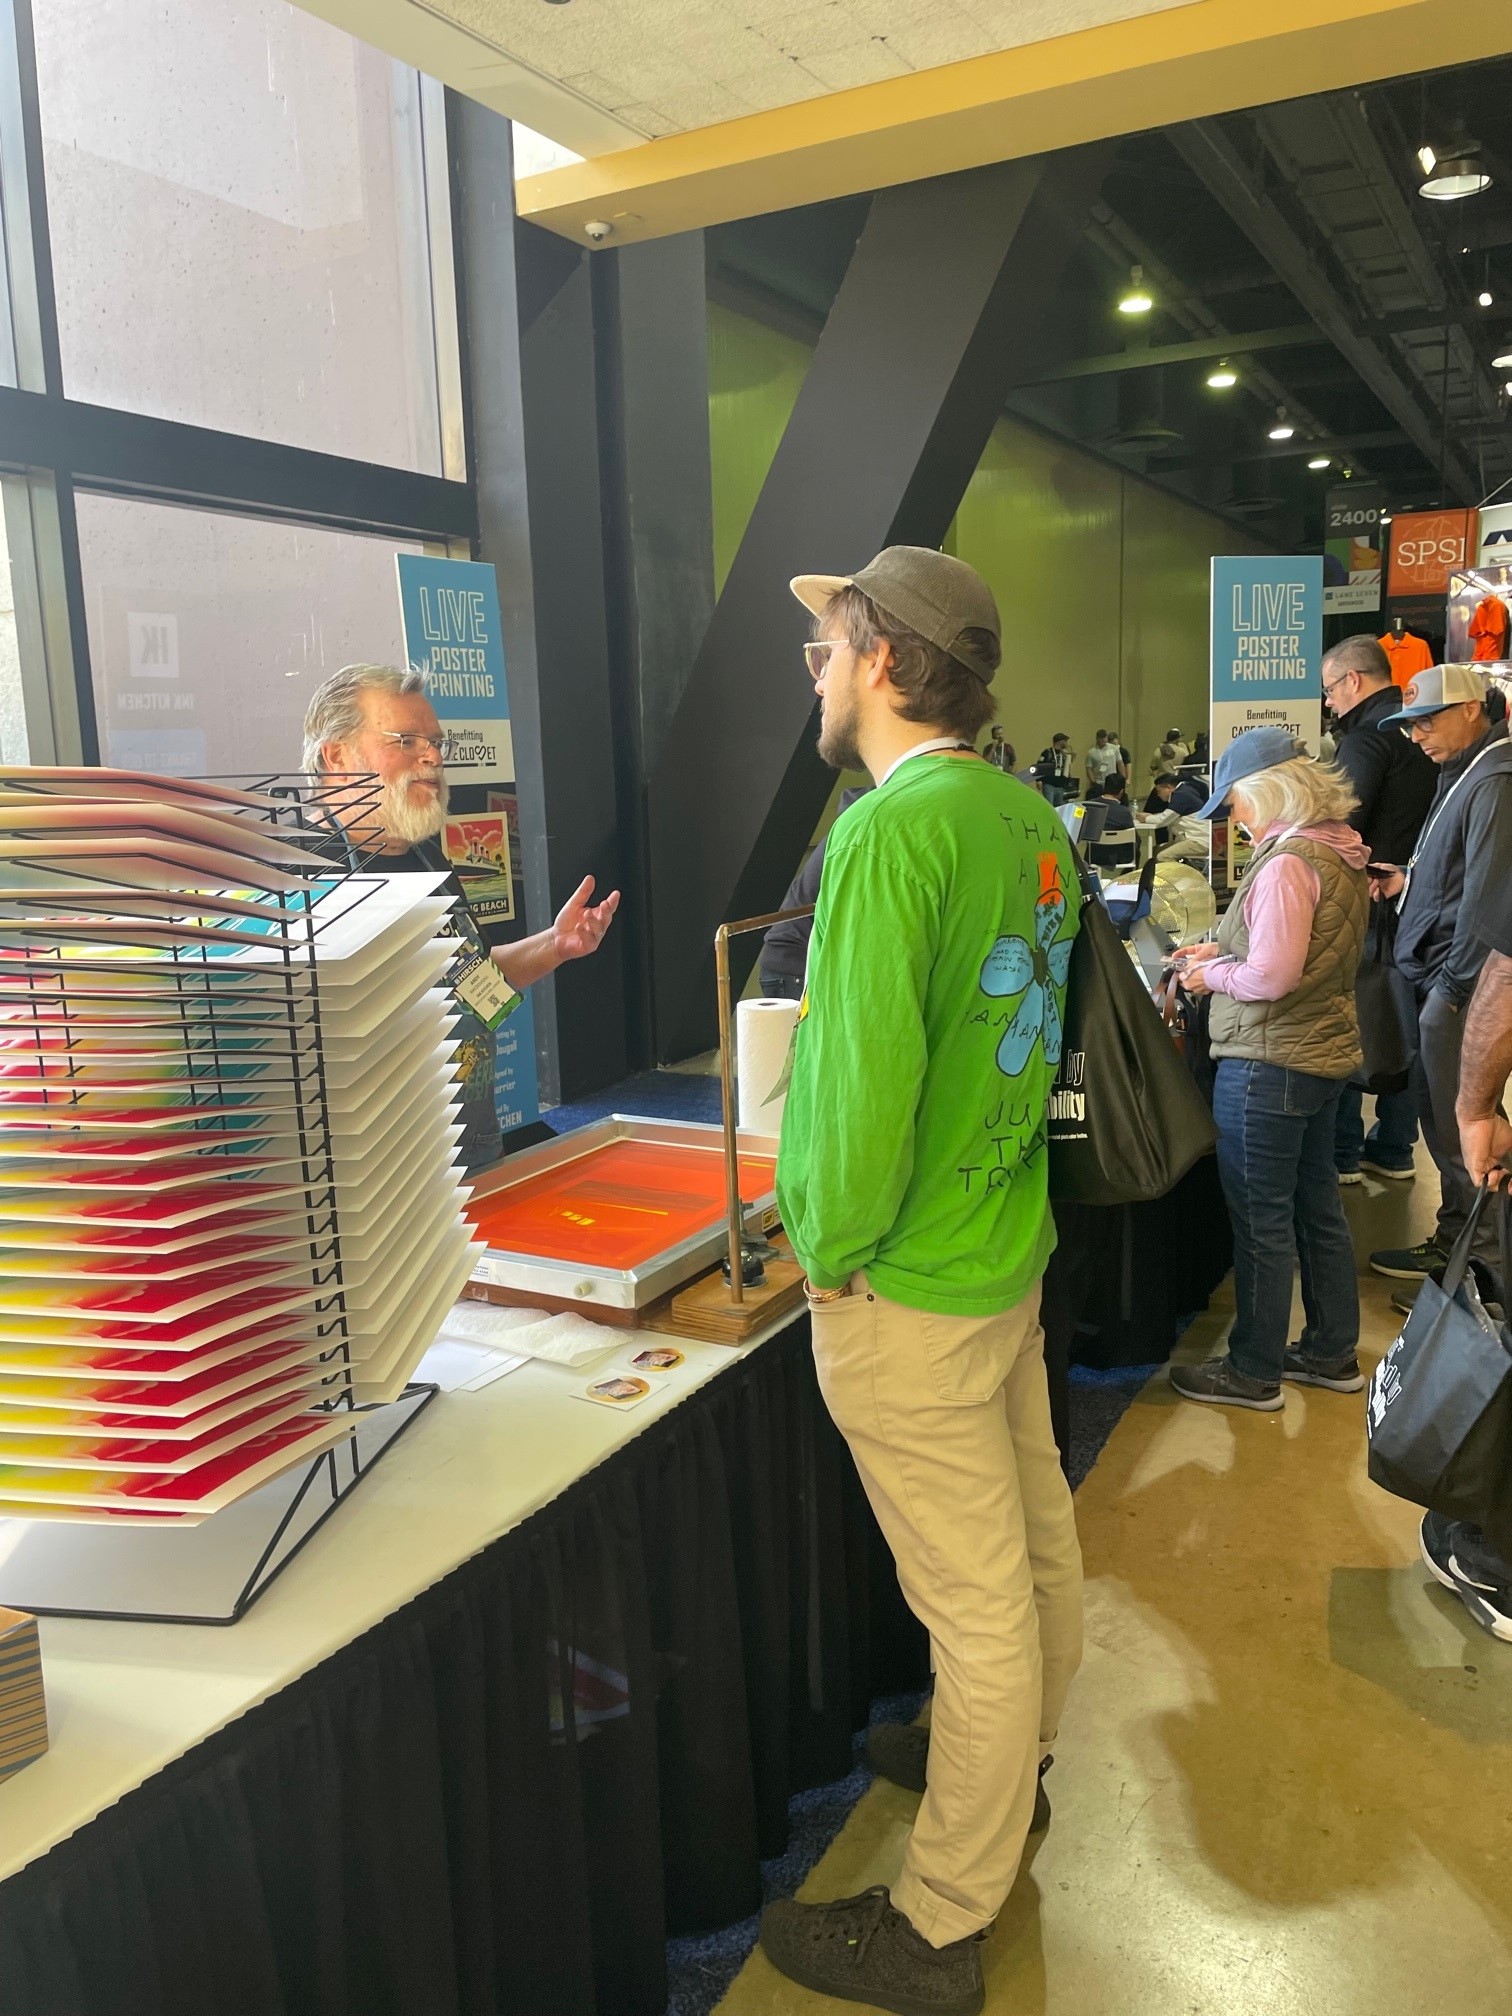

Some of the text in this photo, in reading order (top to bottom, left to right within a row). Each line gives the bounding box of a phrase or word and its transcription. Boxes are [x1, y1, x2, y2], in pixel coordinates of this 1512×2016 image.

[1330, 509, 1377, 527] 2400
[1397, 537, 1465, 567] SPSI
[419, 587, 488, 644] LIVE
[1232, 583, 1305, 632] LIVE
[1238, 635, 1299, 659] POSTER
[430, 646, 487, 674] POSTER
[1232, 658, 1306, 682] PRINTING
[429, 673, 495, 698] PRINTING
[1246, 709, 1287, 721] Benefitting
[447, 728, 484, 743] Benefitting
[481, 899, 507, 912] BEACH
[458, 956, 483, 981] HIRSCH
